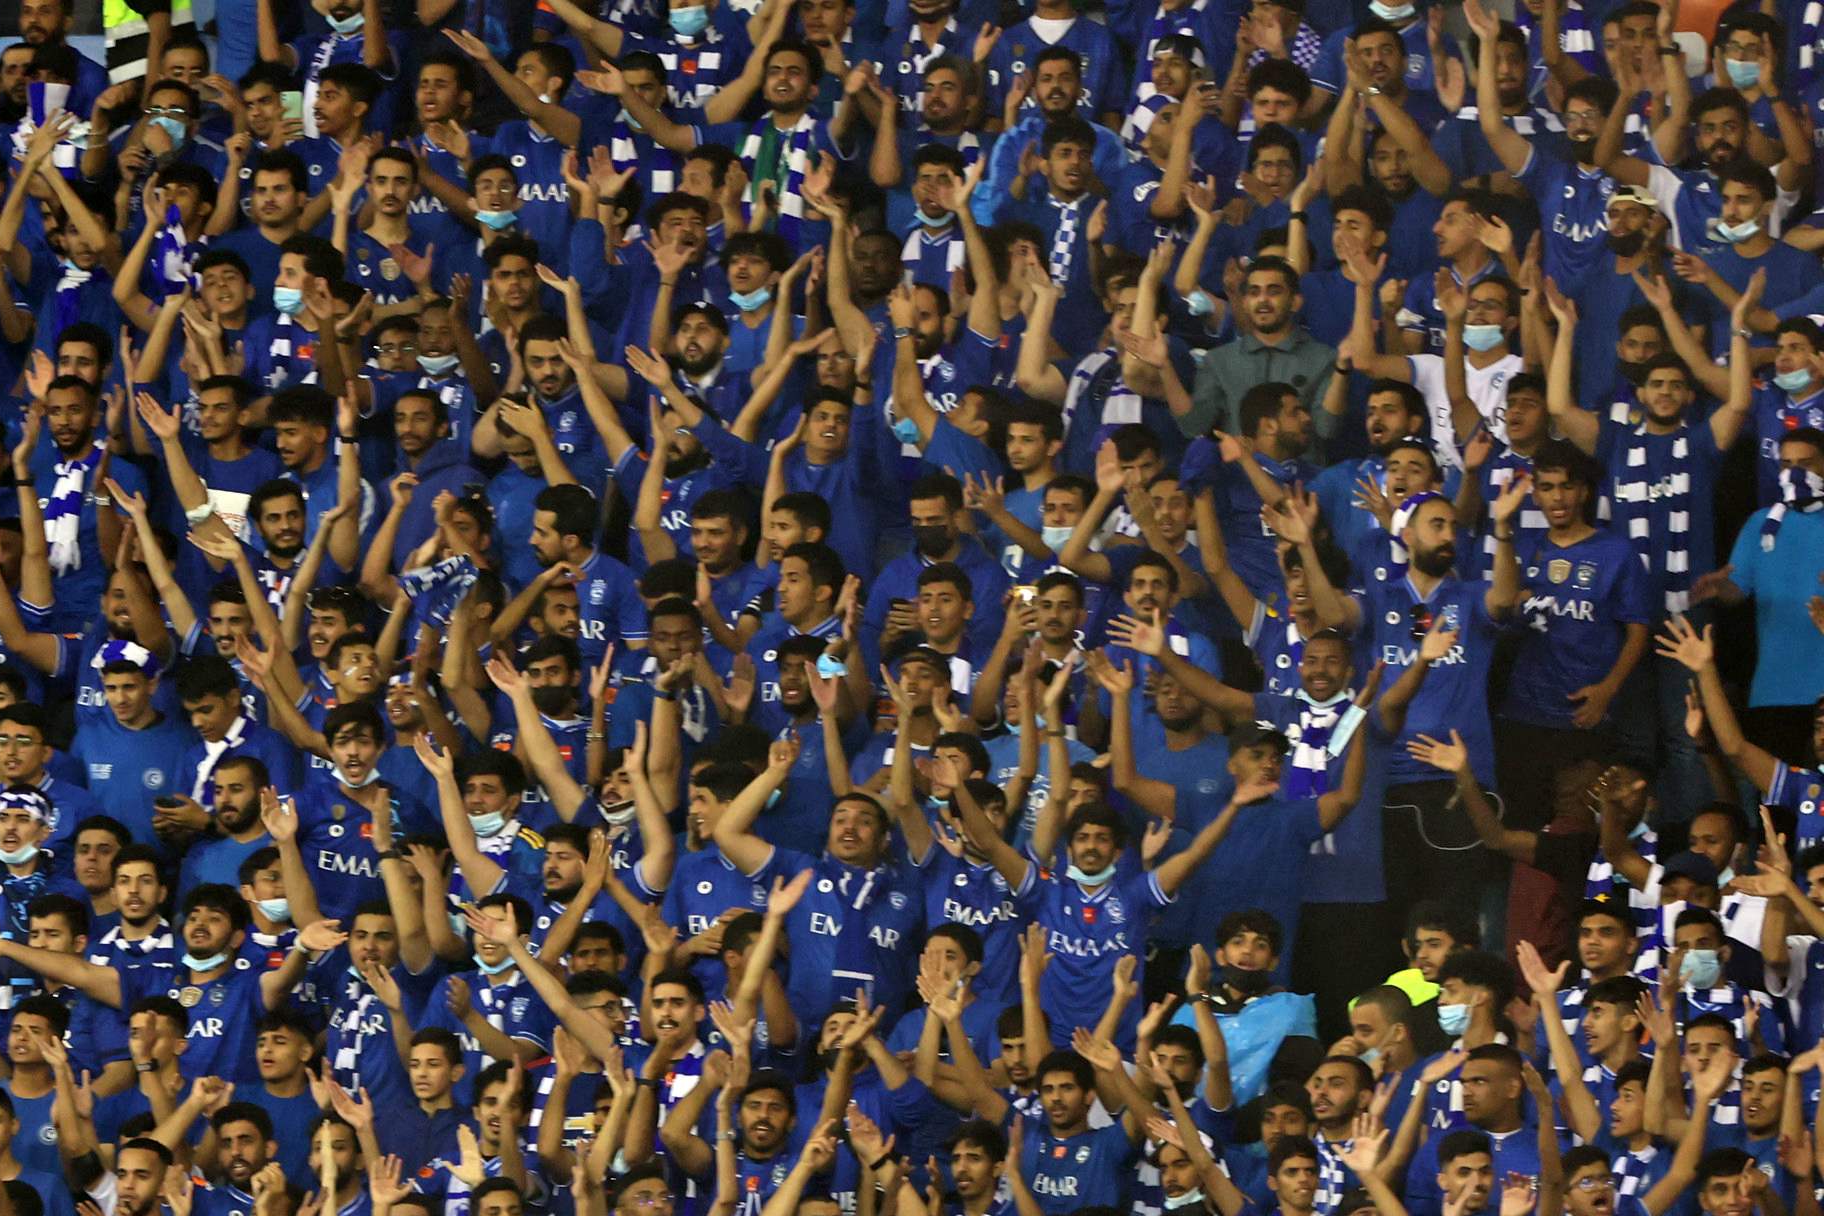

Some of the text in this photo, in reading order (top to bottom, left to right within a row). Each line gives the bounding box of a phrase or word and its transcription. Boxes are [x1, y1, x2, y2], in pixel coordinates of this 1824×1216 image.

[318, 849, 382, 879] EMA
[943, 898, 1019, 926] EMAAR
[1049, 930, 1130, 957] EMAAR
